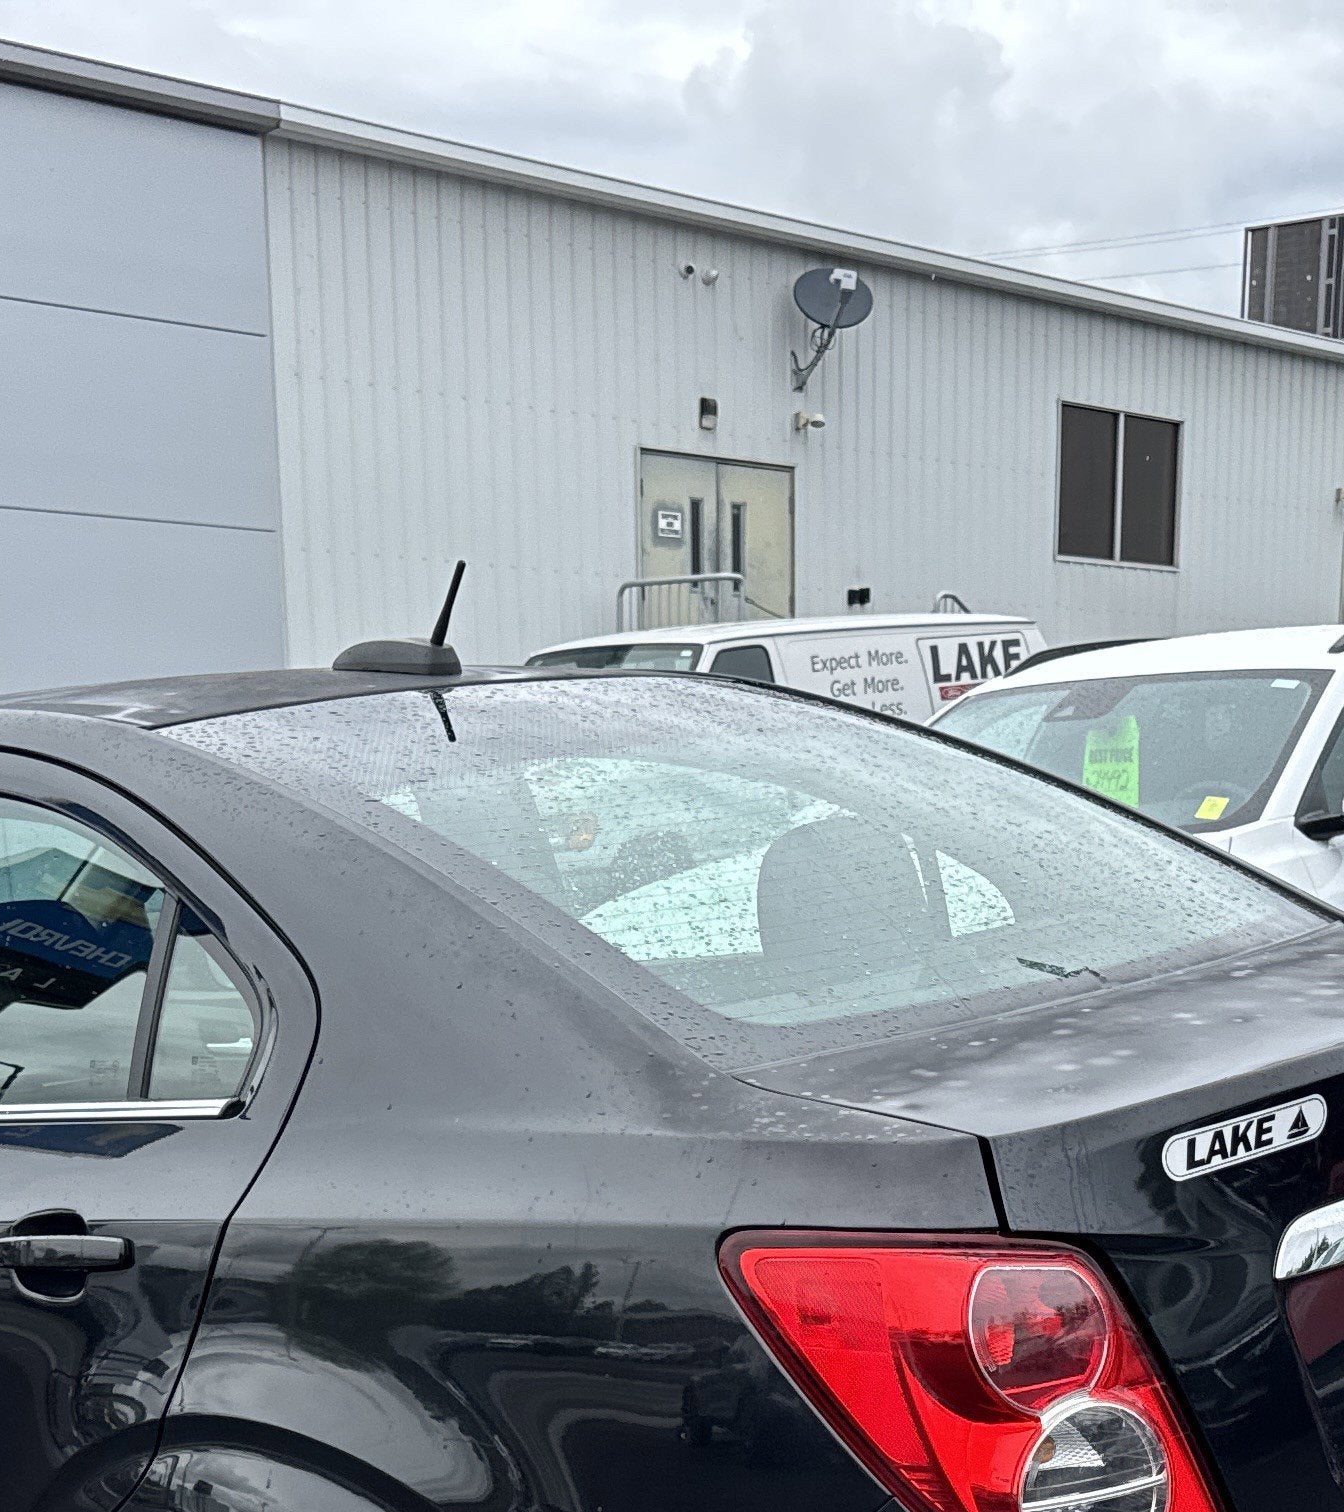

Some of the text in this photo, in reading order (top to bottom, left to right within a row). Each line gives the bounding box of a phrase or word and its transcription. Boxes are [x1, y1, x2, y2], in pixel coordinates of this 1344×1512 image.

[810, 649, 908, 675] Expect More.
[929, 638, 1021, 684] LAKE
[829, 676, 904, 698] Get More.
[1185, 1113, 1277, 1171] LAKE
